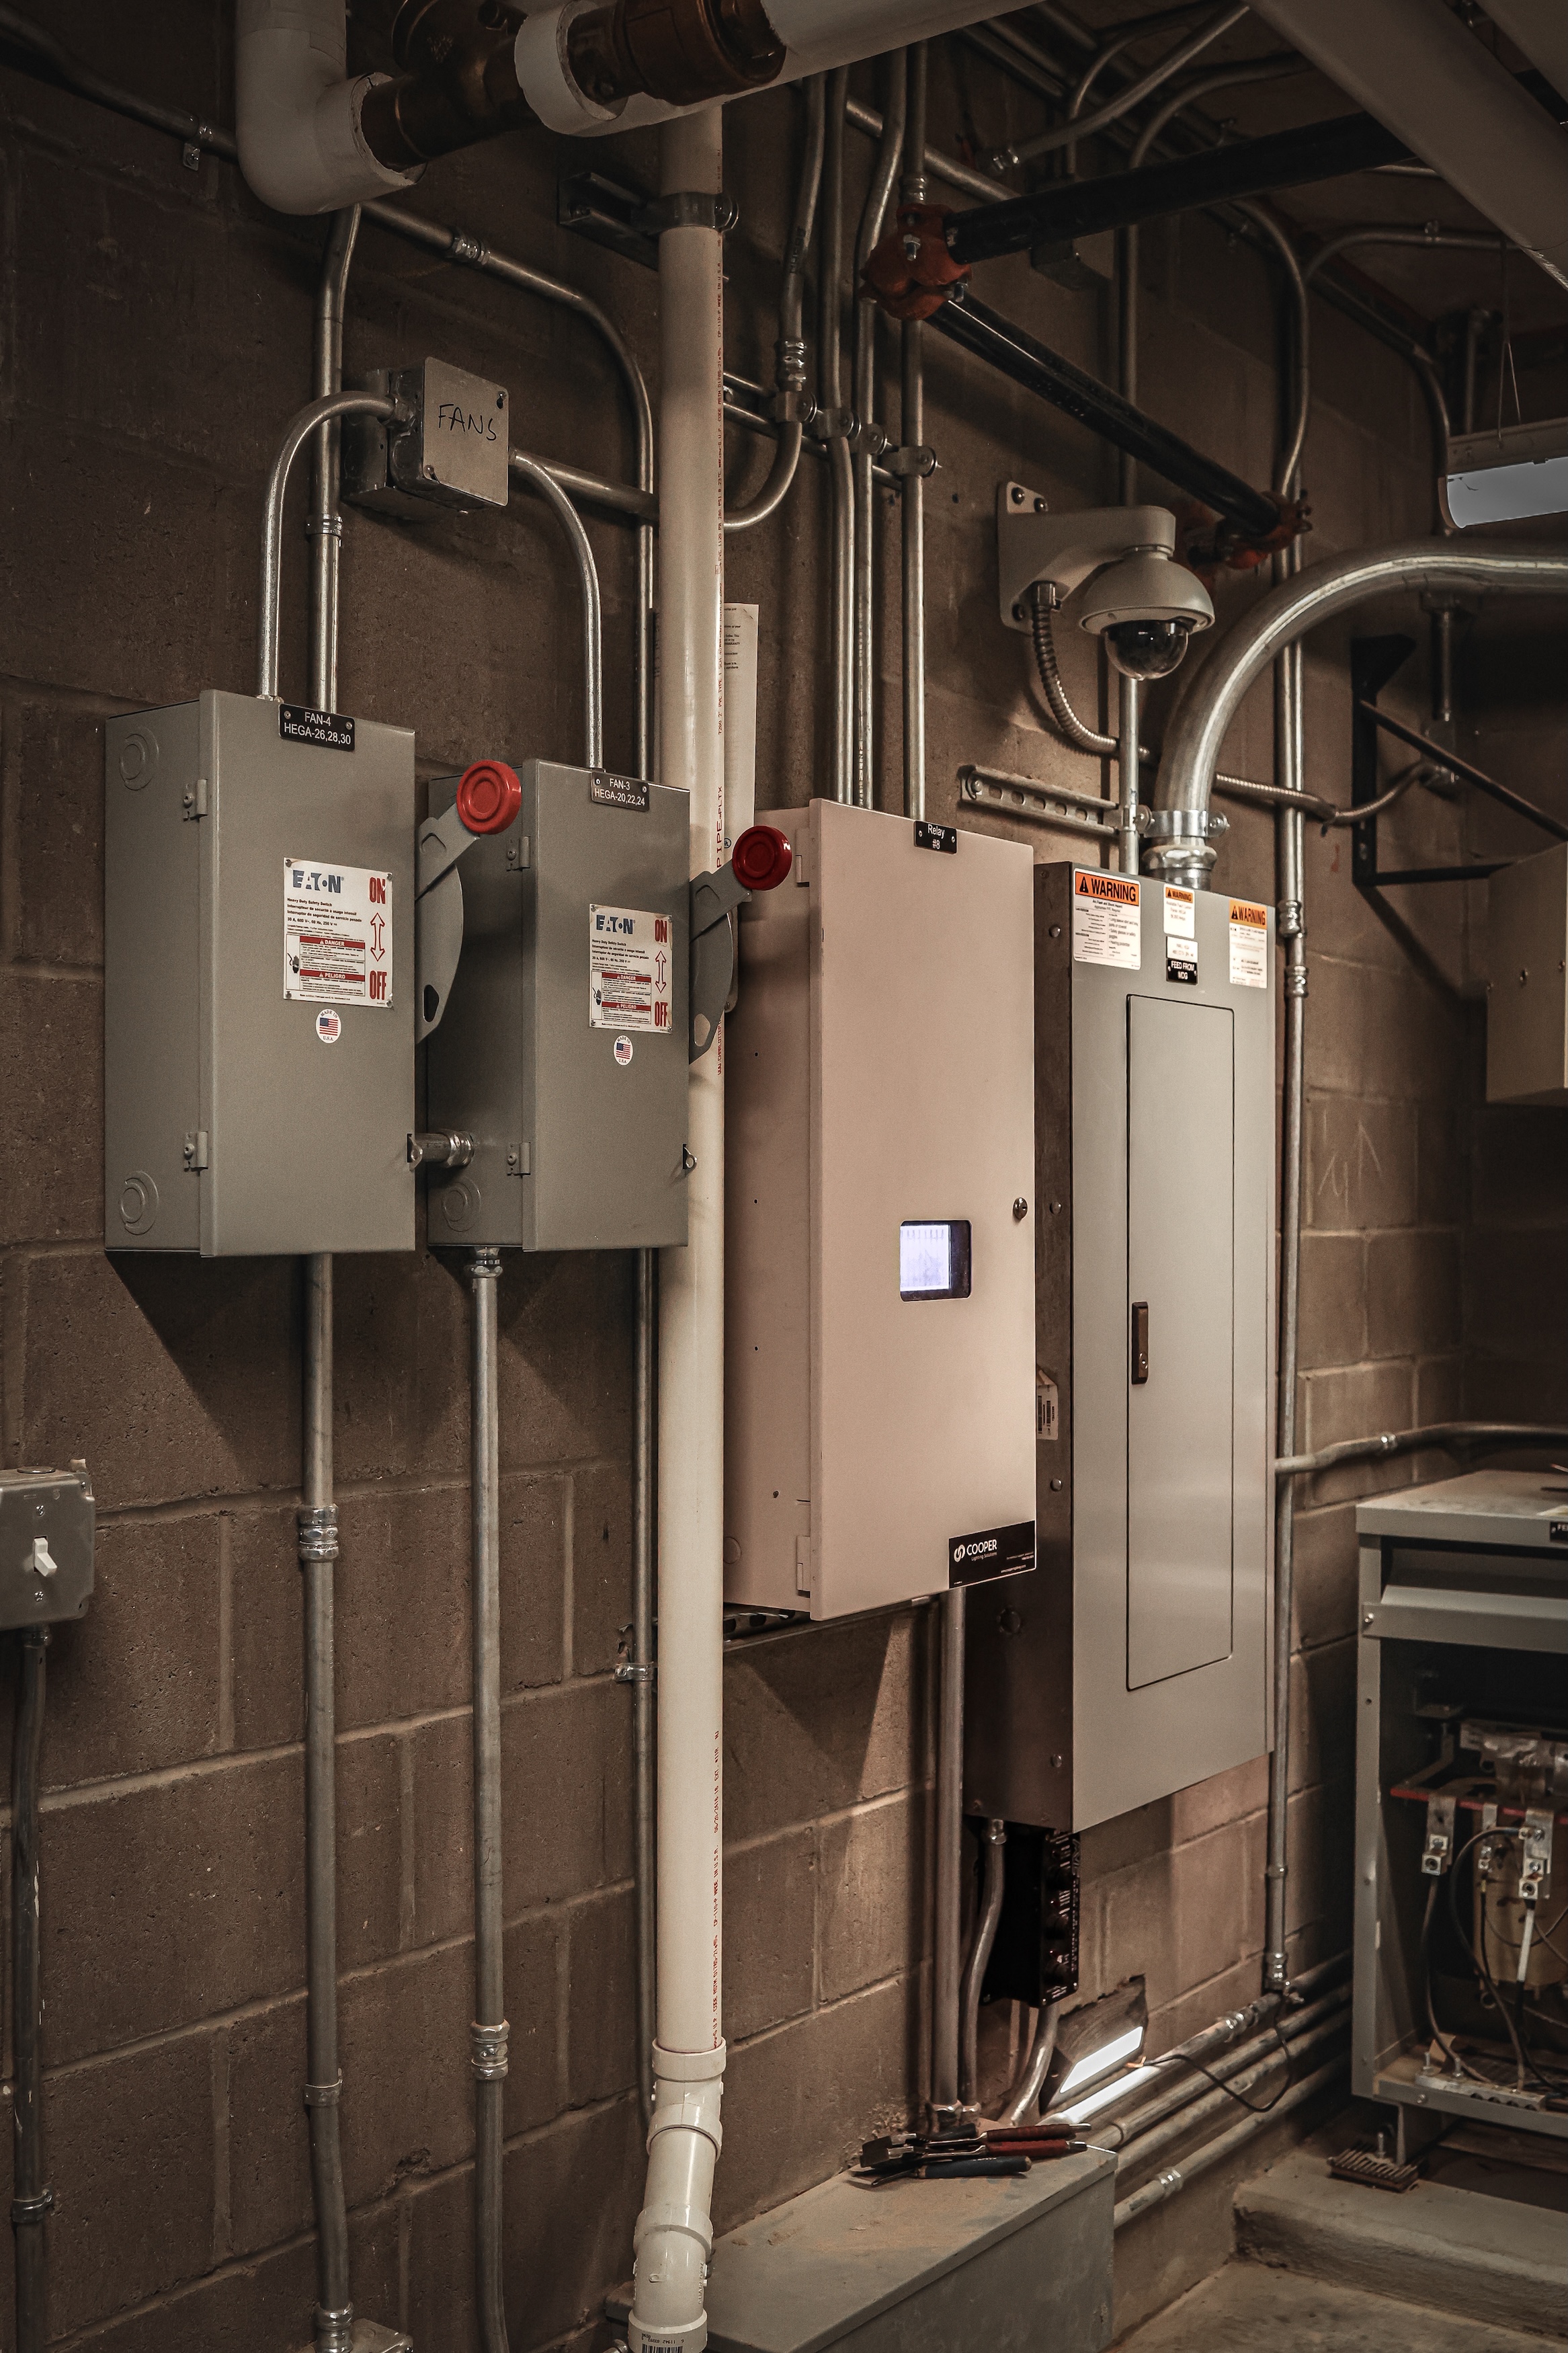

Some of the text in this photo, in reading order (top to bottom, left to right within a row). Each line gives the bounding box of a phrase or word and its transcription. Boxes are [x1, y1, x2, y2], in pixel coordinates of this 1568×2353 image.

[438, 403, 496, 441] FANS
[718, 522, 722, 530] PR
[304, 712, 331, 726] FAN-4
[284, 722, 351, 745] HEGA-26,28,30
[610, 778, 630, 791] FAN-3
[594, 788, 645, 806] HEGA-20,22,24
[927, 824, 945, 839] Relay
[932, 839, 940, 849] #8
[293, 870, 341, 893] EATON
[369, 877, 386, 904] ON
[1091, 878, 1136, 902] WARNING
[1172, 891, 1192, 902] WARNING
[596, 914, 633, 934] EATON
[1238, 906, 1266, 925] WARNING
[655, 920, 667, 943] ON
[1171, 960, 1195, 971] FEED FROM
[370, 970, 387, 1000] OFF
[655, 1002, 668, 1027] OFF
[966, 1539, 997, 1556] COOPER
[713, 1869, 718, 1878] IN
